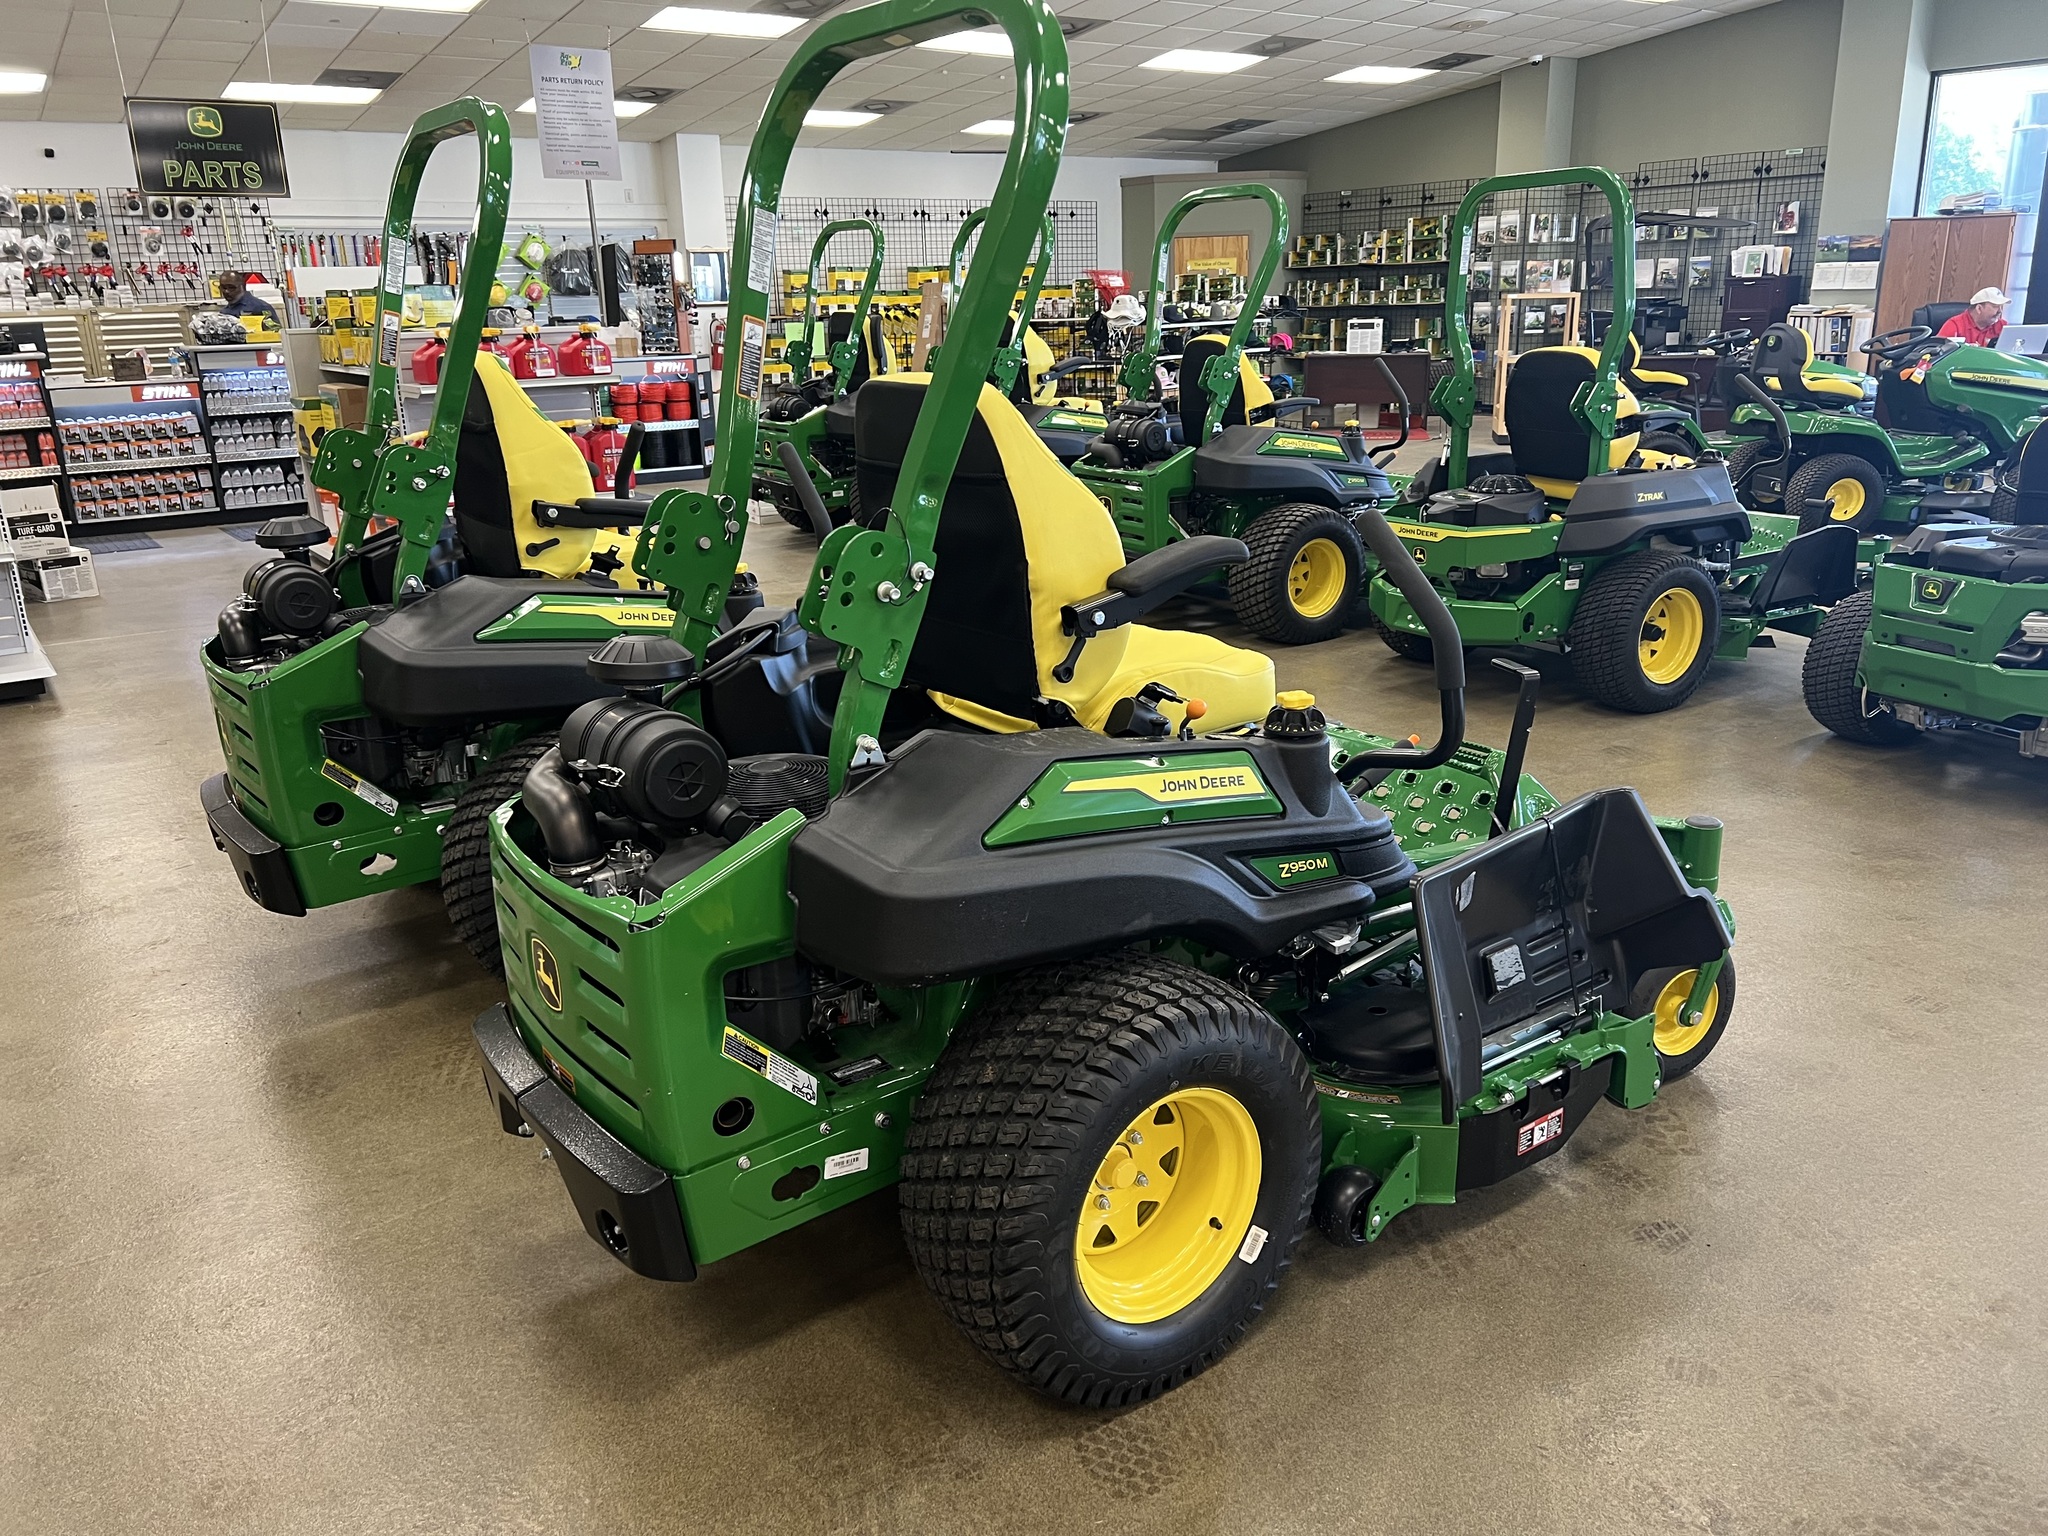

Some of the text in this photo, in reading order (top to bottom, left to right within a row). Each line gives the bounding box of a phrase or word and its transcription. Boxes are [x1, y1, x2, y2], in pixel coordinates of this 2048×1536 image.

[175, 140, 243, 151] JOHN DEERE
[162, 159, 263, 189] PARTS
[0, 361, 31, 378] IHL
[653, 361, 689, 373] STIHL
[1970, 373, 2011, 384] JOHN DEERE
[142, 385, 192, 399] STIHL
[1280, 439, 1319, 449] JOHN DEERE
[1637, 492, 1664, 502] ZTRAK
[16, 524, 55, 535] TURF-GARD
[1398, 527, 1439, 538] JOHN DEERE
[618, 611, 675, 621] JOHN DEE
[1160, 775, 1246, 794] JOHN DEERE
[1279, 859, 1328, 878] Z950M
